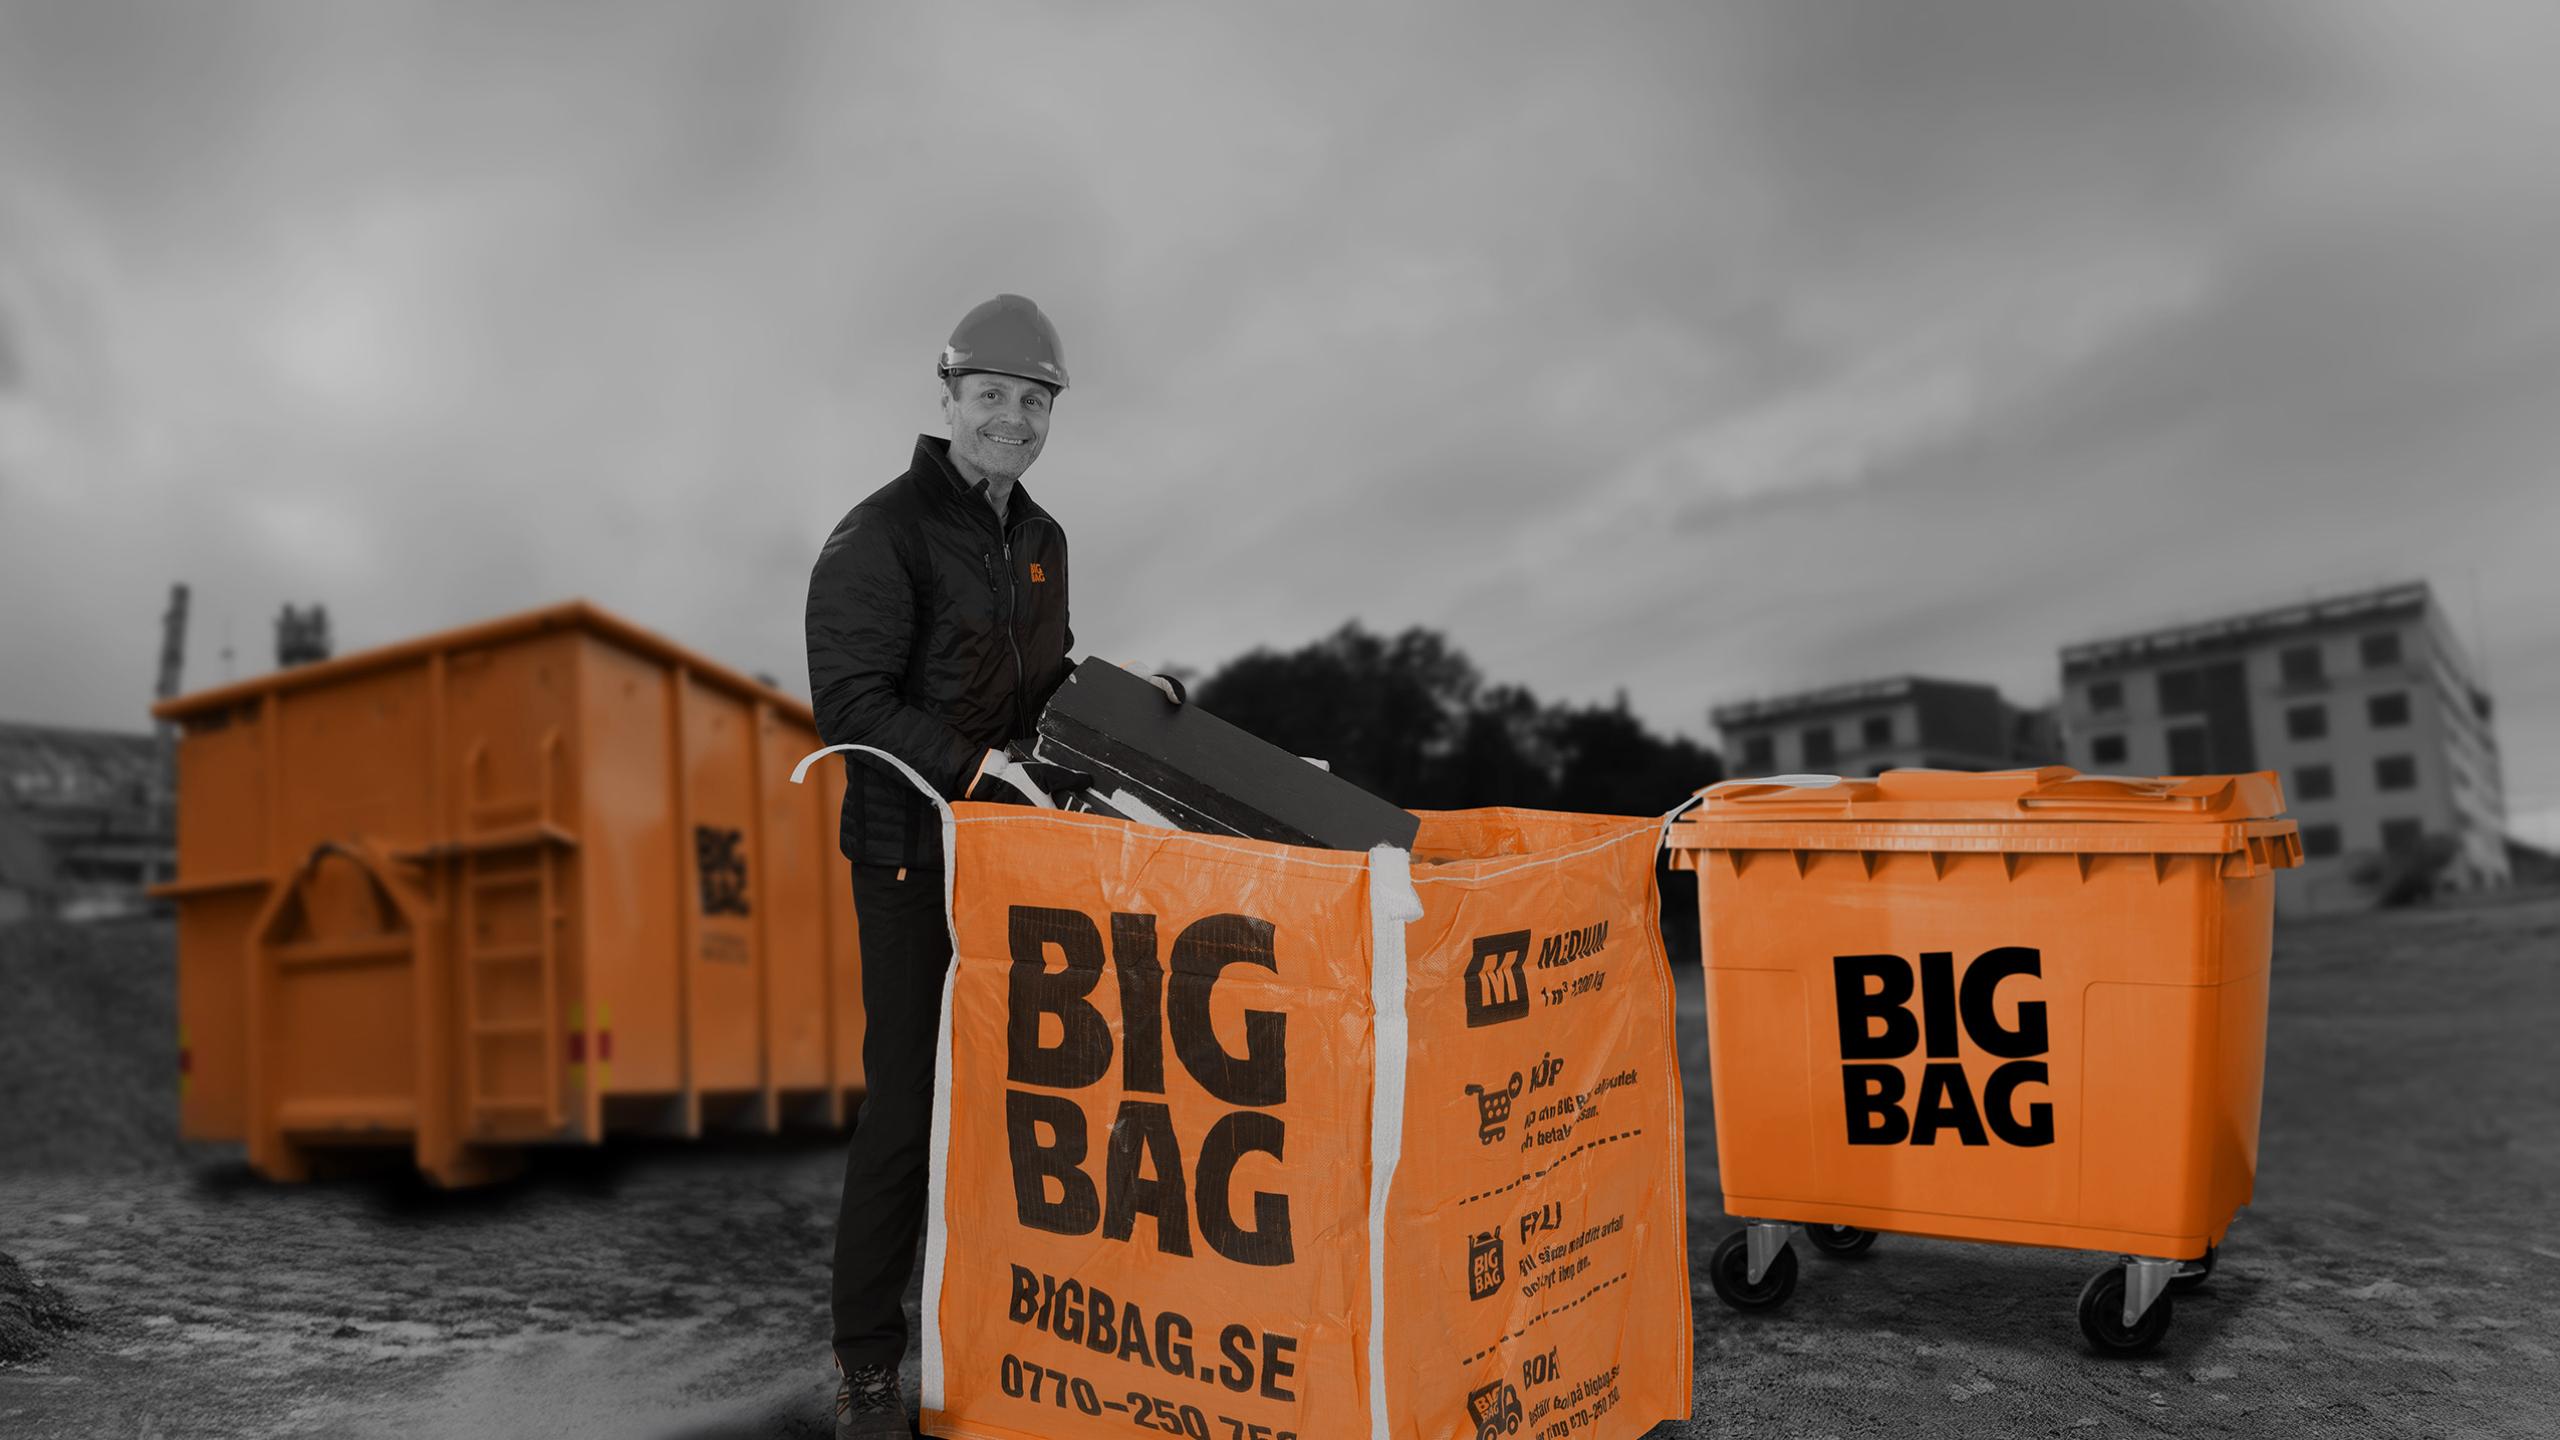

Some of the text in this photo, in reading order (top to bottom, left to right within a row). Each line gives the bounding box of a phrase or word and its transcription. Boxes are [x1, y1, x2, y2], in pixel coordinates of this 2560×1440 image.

[1006, 905, 1288, 1108] BIG
[1833, 946, 2049, 1060] BIG
[1842, 1060, 2055, 1147] BAG
[1006, 1089, 1295, 1266] BAG
[1474, 1247, 1498, 1277] BIG
[1475, 1267, 1501, 1293] BAG
[1008, 1263, 1298, 1402] BIGBAG.SE
